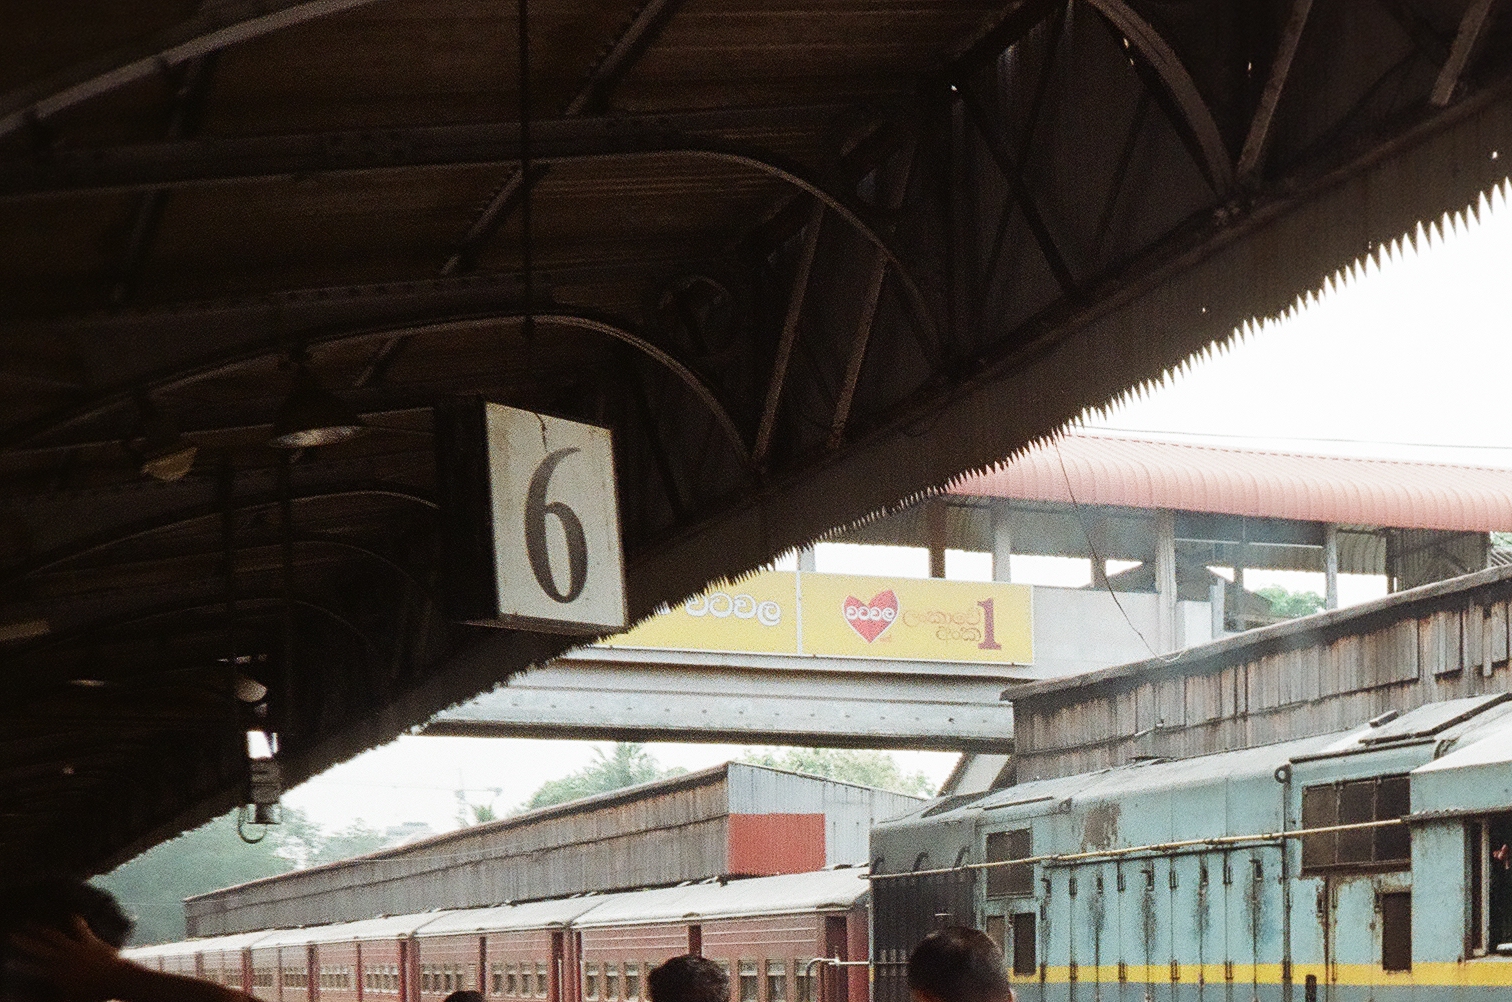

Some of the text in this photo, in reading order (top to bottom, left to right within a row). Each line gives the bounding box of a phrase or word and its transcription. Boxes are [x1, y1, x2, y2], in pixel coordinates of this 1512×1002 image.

[525, 446, 588, 604] 6
[846, 605, 895, 622] වටවල
[977, 598, 1002, 650] 1
